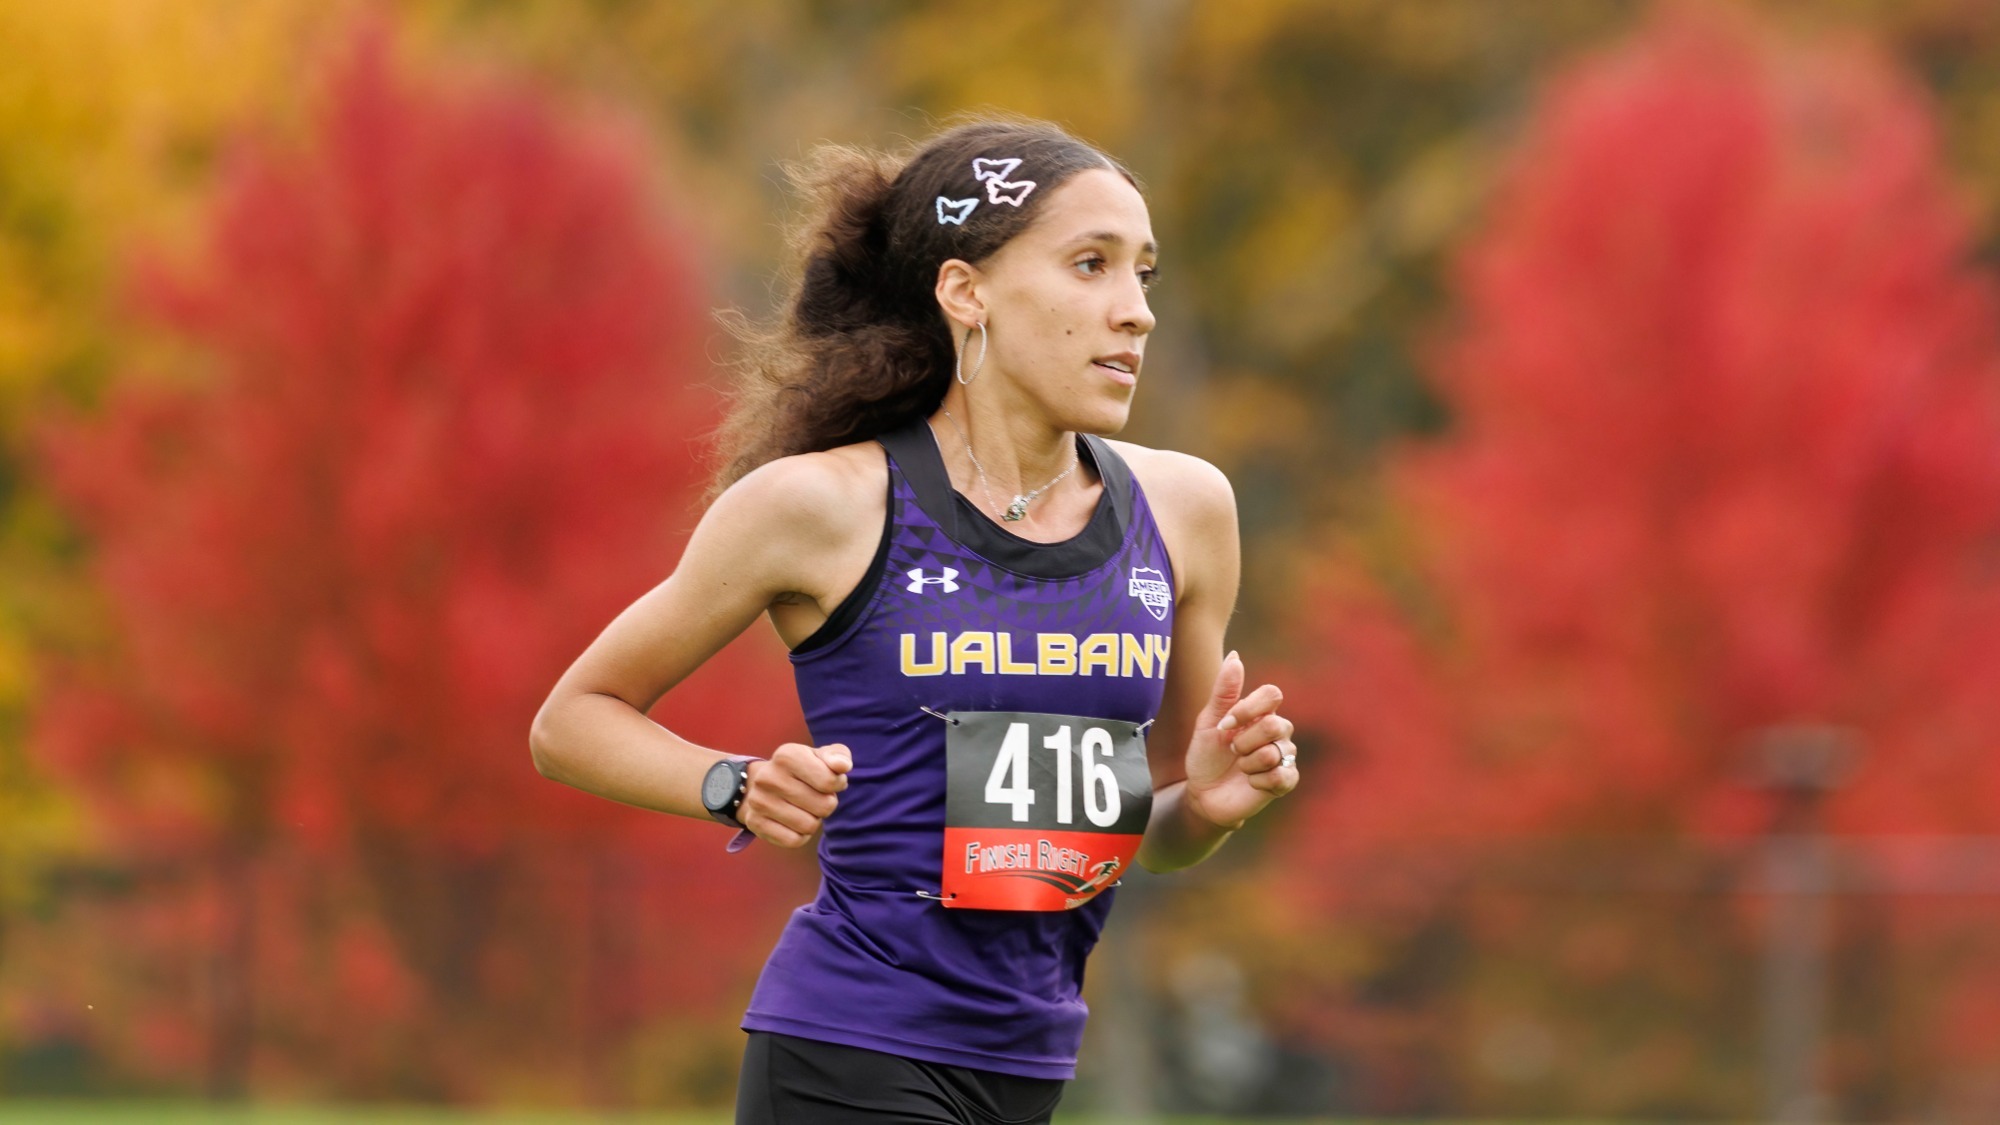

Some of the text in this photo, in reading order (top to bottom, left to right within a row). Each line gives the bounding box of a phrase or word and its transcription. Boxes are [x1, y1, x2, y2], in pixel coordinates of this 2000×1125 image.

[1144, 592, 1167, 605] EAST
[900, 631, 1171, 679] UALBANY
[984, 722, 1121, 827] 416
[965, 839, 1089, 877] FINISH RIGHT
